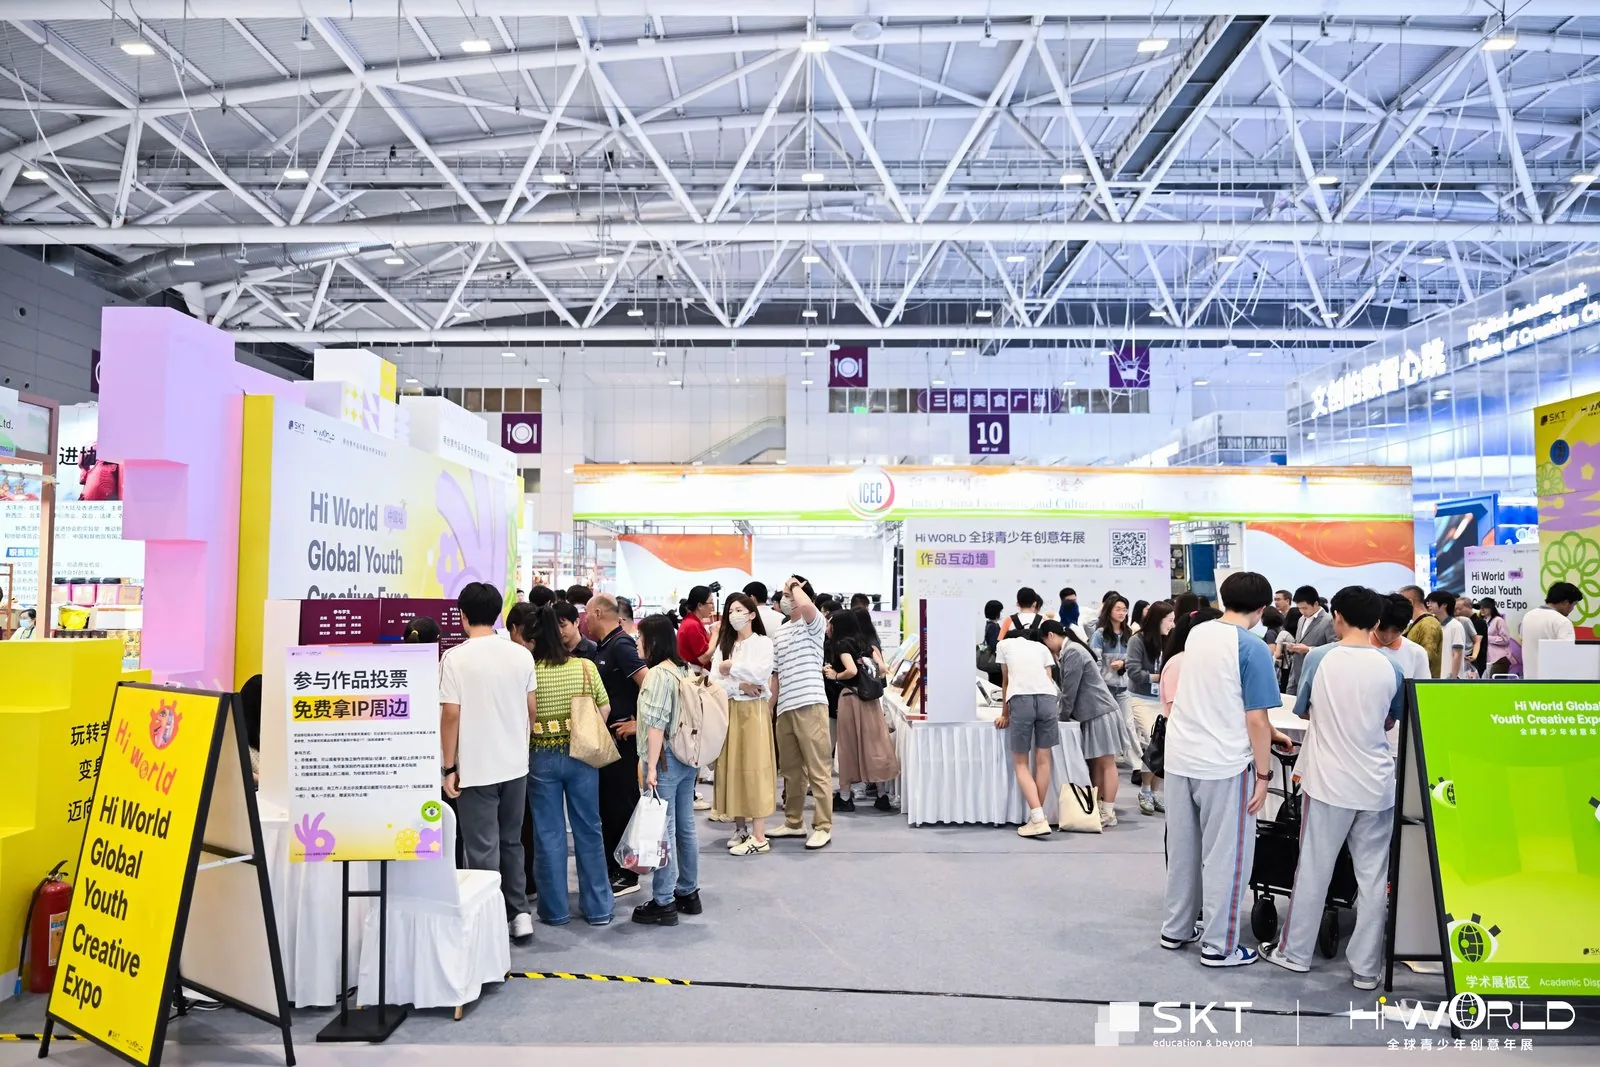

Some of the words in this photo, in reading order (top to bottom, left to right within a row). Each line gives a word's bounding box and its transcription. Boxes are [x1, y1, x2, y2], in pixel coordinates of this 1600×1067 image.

[933, 393, 1048, 408] 三楼美食广场
[976, 421, 1003, 445] 10
[859, 483, 882, 504] ICEC
[310, 491, 328, 524] Hi
[332, 495, 379, 532] World
[915, 533, 927, 543] Hi
[928, 533, 967, 543] WORLD
[969, 530, 1086, 545] 全球青少年创意年展
[308, 539, 361, 572] Global
[364, 545, 403, 575] Youth
[920, 552, 989, 566] 作品互动墙
[1472, 571, 1480, 581] Hi
[1481, 571, 1505, 581] World
[1471, 585, 1497, 595] Global
[1498, 585, 1523, 596] Youth
[1506, 599, 1528, 612] Expo
[293, 669, 408, 691] 参与作品投票
[294, 698, 408, 719] 免费拿IP周边
[1514, 700, 1527, 711] Hi
[1529, 700, 1564, 711] World
[1490, 714, 1525, 724] Youth
[1527, 714, 1576, 724] Creative
[1520, 728, 1600, 736] 全球青少年创意年
[99, 795, 119, 825] Hi
[120, 799, 172, 840] World
[90, 837, 144, 879] Global
[84, 877, 129, 921] Youth
[72, 923, 141, 978] Creative
[62, 964, 103, 1010] Expo
[1465, 975, 1531, 989] 学术展板区
[1539, 977, 1582, 987] Academic
